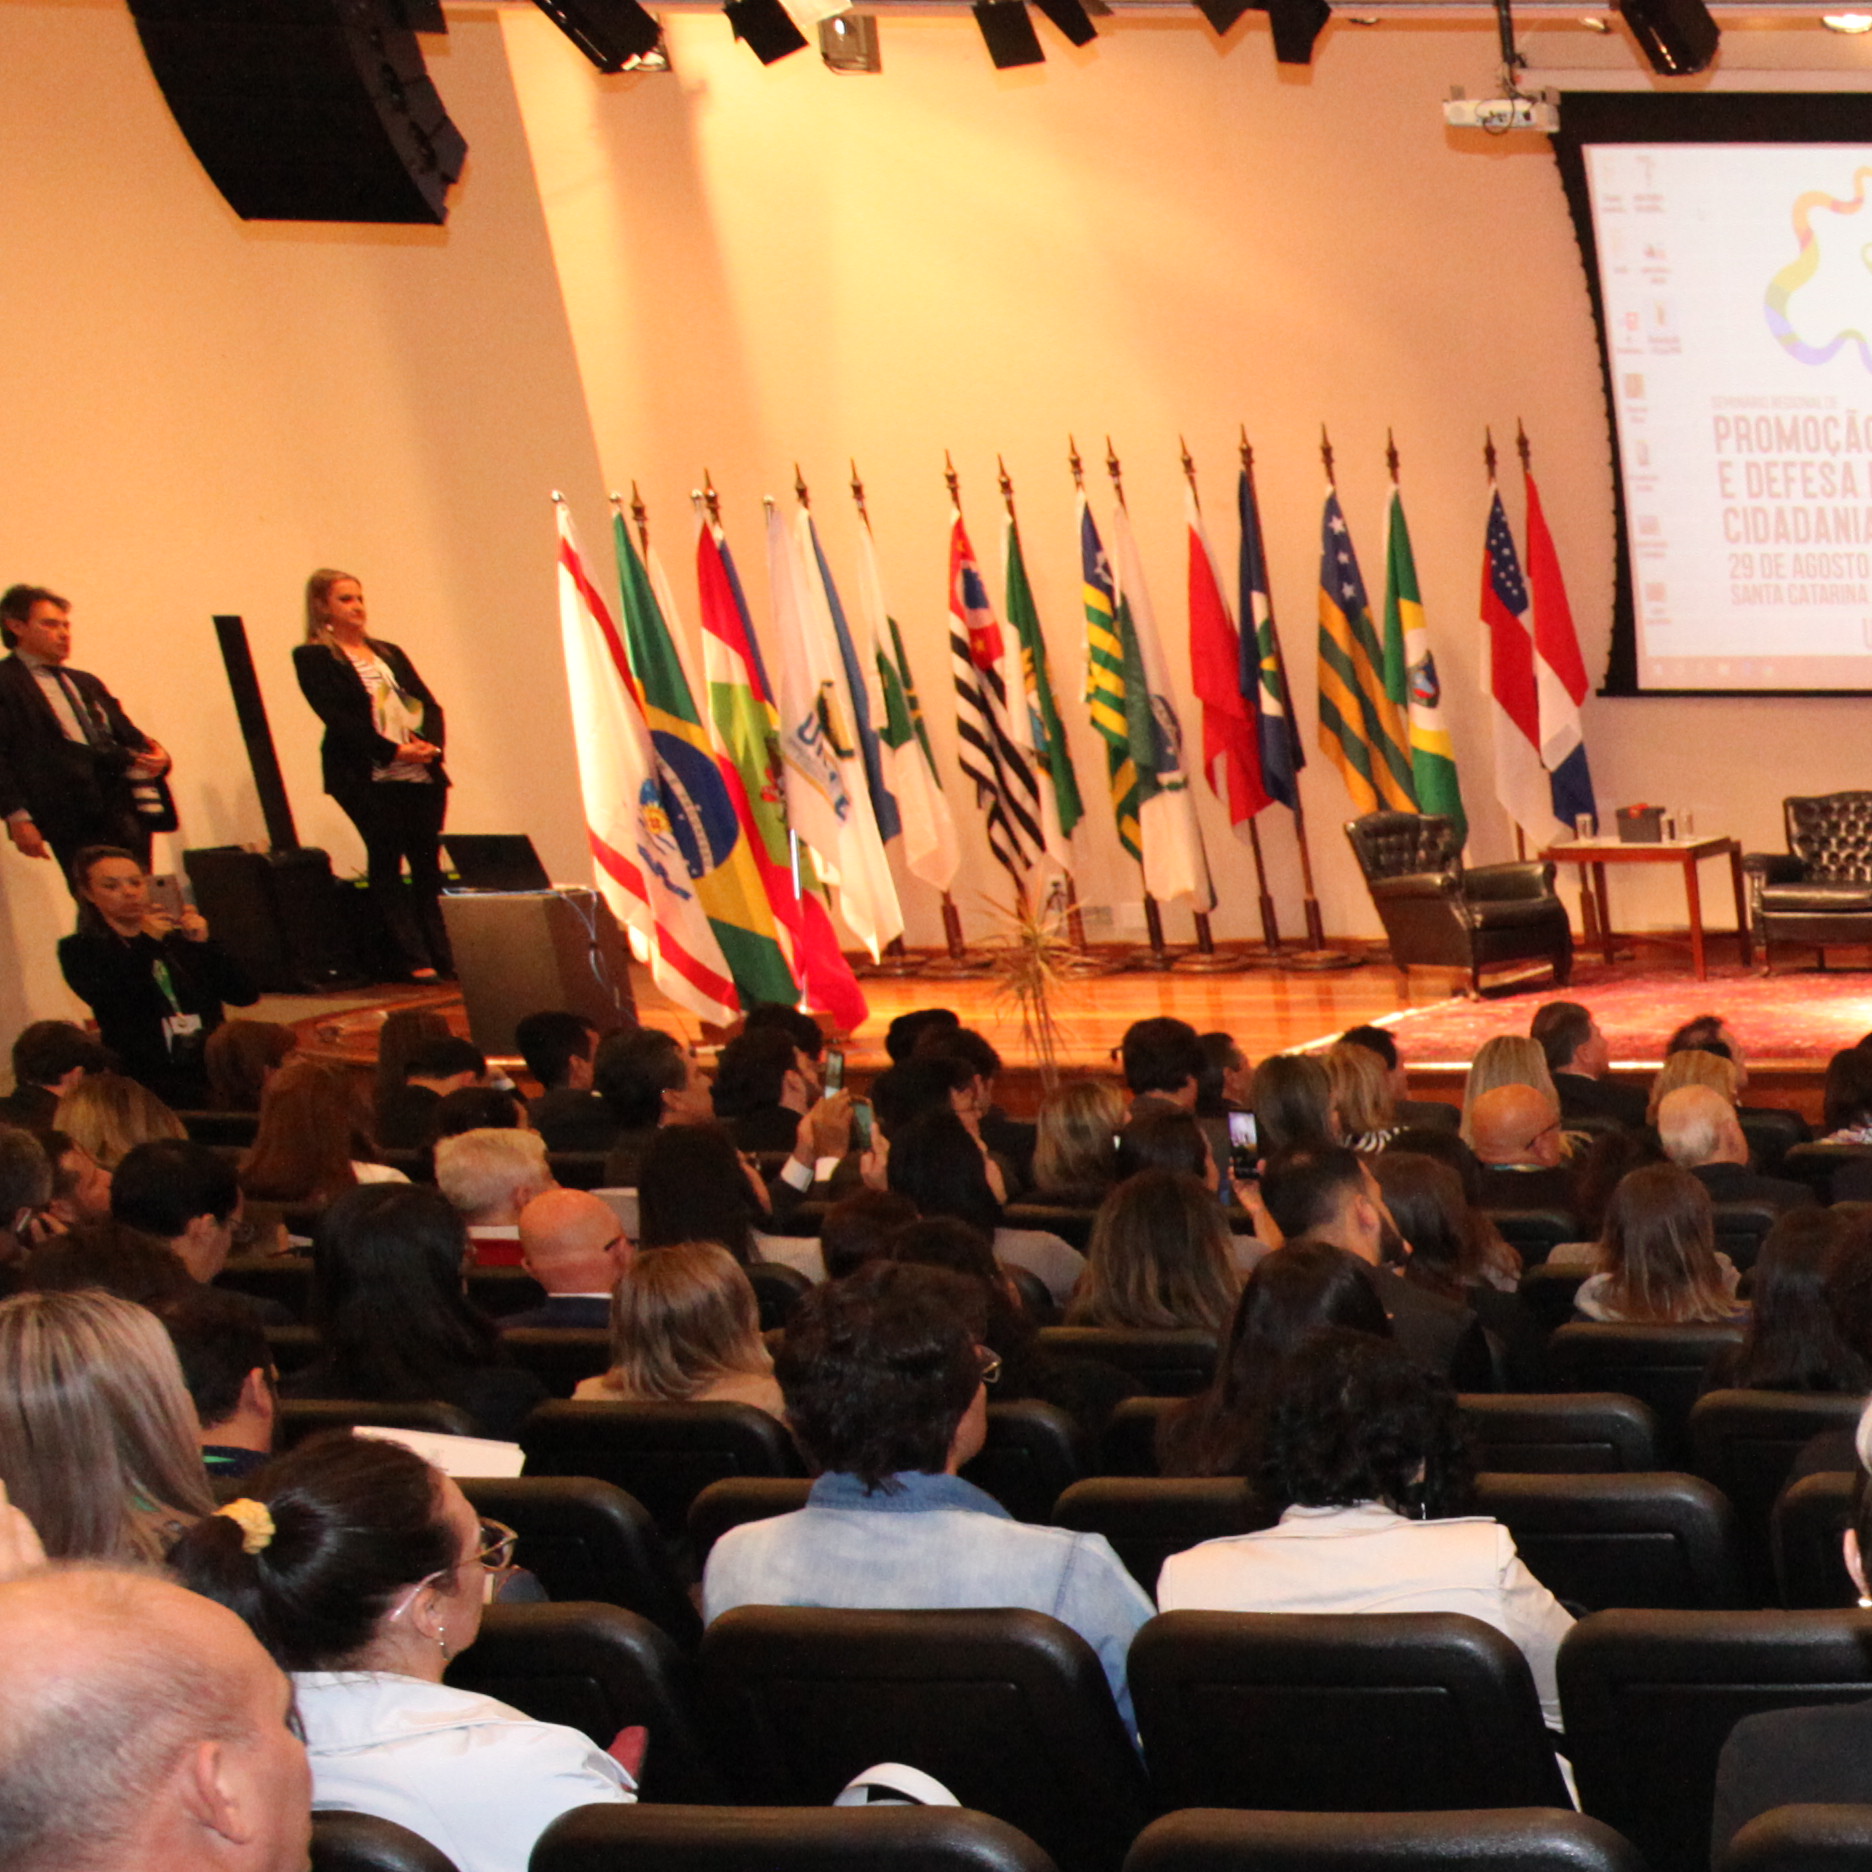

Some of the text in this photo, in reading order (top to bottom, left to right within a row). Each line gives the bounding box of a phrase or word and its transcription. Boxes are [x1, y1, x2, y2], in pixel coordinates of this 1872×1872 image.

[1720, 461, 1736, 499] E
[1746, 461, 1858, 499] DEFESA
[1729, 552, 1870, 580] 29 DE AGOSTO
[1731, 583, 1868, 606] SANTA CATARINA
